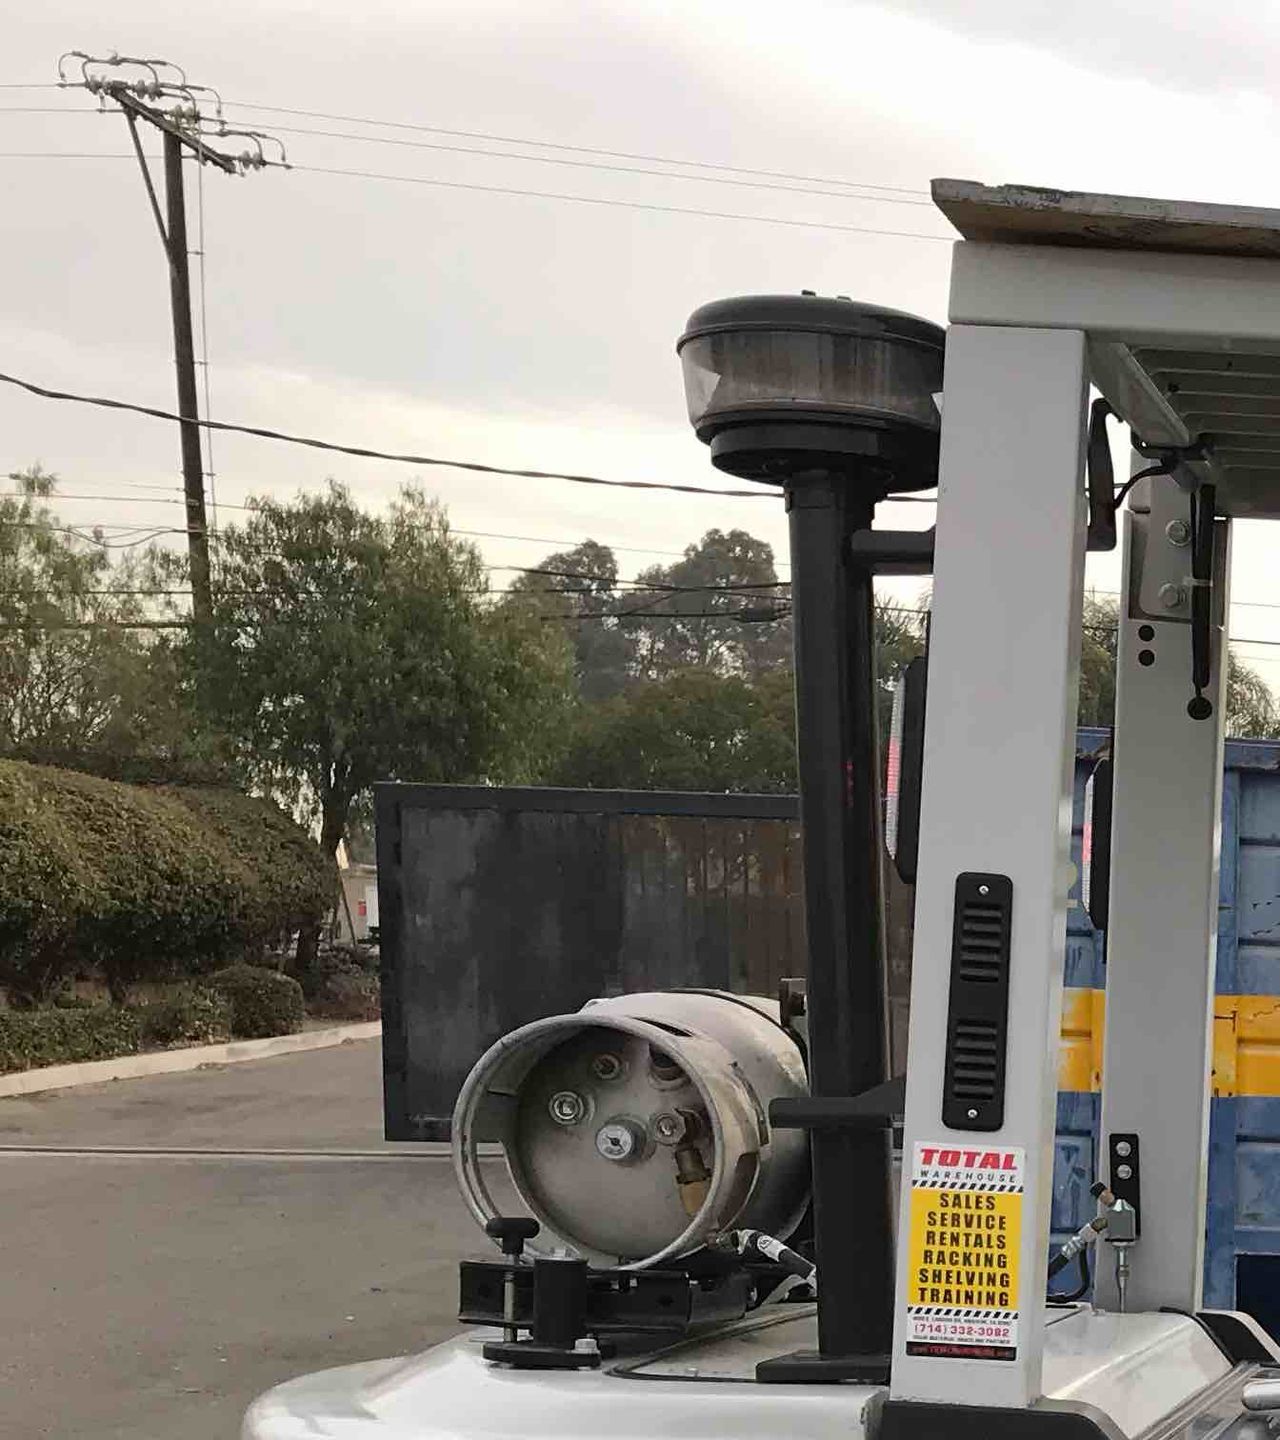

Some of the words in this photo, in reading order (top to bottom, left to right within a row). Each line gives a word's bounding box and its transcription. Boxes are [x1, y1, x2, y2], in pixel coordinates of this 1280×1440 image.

[920, 1148, 1018, 1170] TOTAL
[919, 1170, 1016, 1183] WAREHOUSE
[939, 1192, 996, 1211] SALES
[927, 1211, 1007, 1231] SERVICE
[926, 1230, 1006, 1249] RENTALS
[923, 1249, 1008, 1268] RACKING
[919, 1268, 1010, 1288] SHELVING
[918, 1287, 1010, 1307] TRAINING
[914, 1323, 947, 1335] (714)
